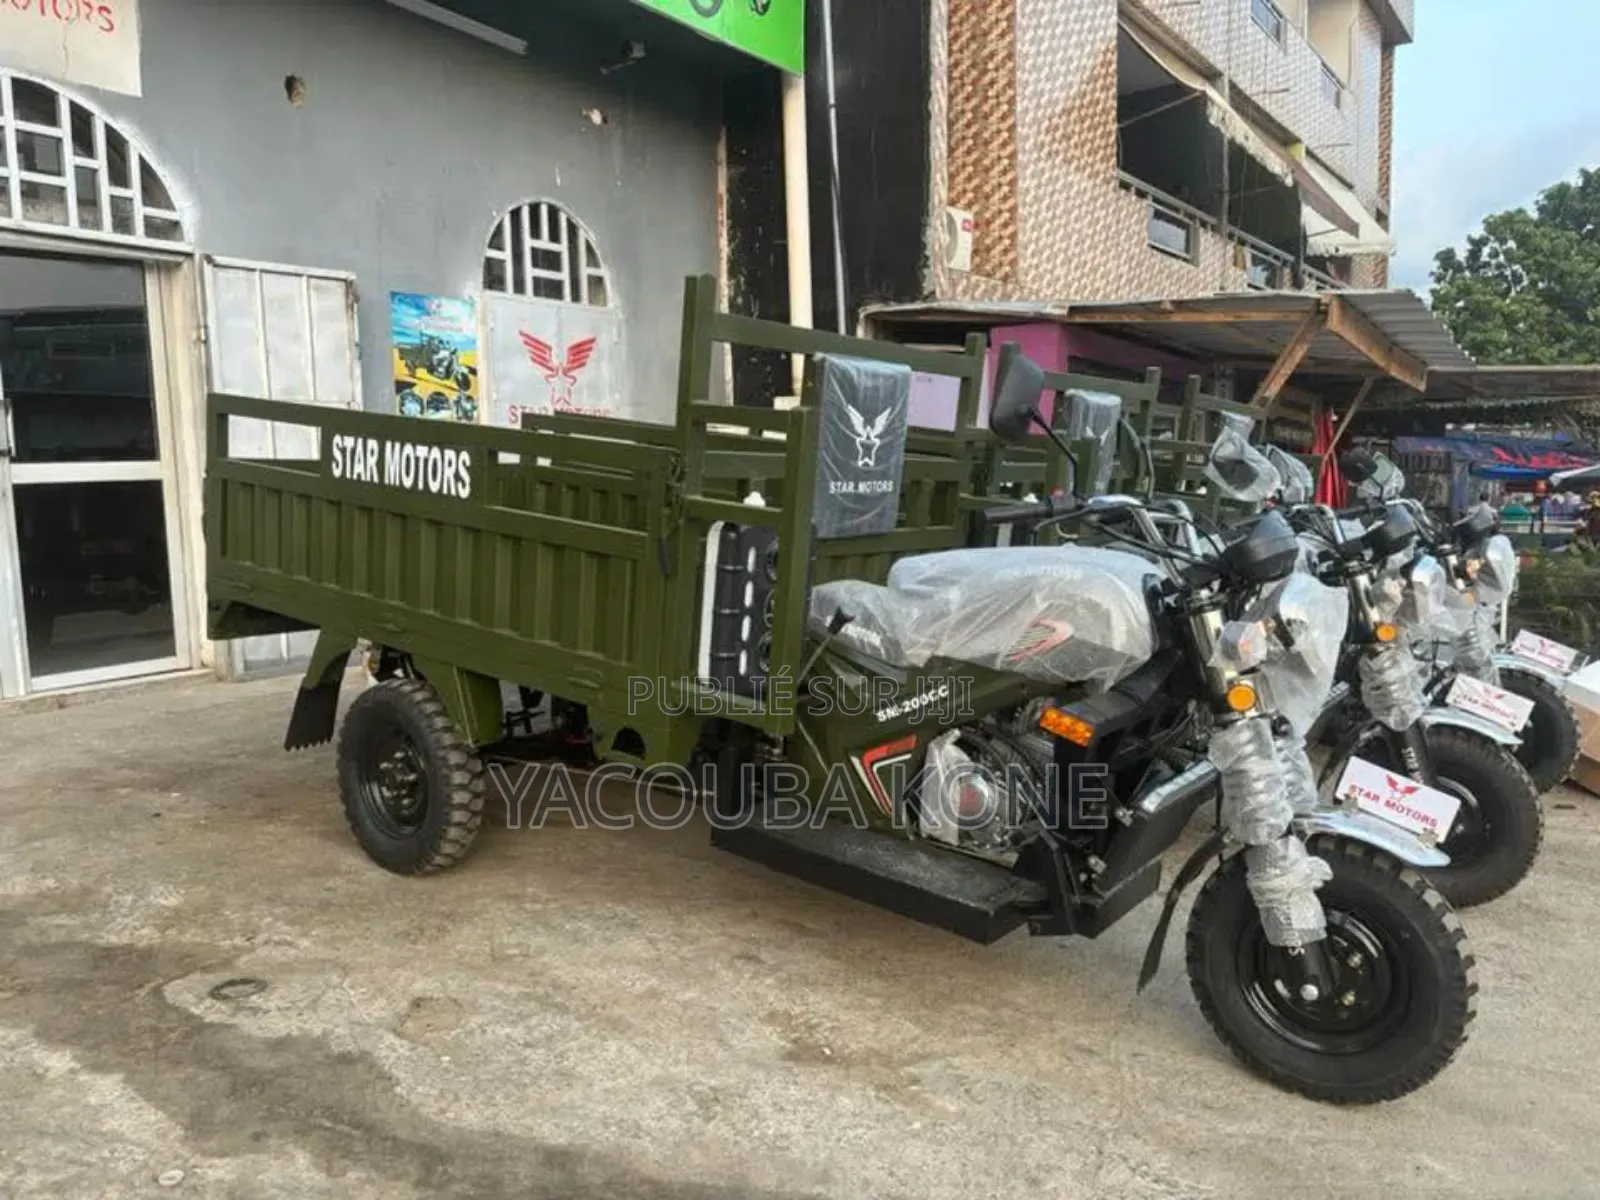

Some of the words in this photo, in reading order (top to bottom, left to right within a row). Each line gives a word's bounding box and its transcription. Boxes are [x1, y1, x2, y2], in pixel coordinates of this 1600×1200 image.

[332, 434, 379, 483] STAR
[385, 440, 471, 499] MOTORS
[829, 481, 854, 494] STAR
[858, 480, 893, 494] MOTORS
[1349, 784, 1381, 802] STAR
[1384, 799, 1439, 828] MOTORS
